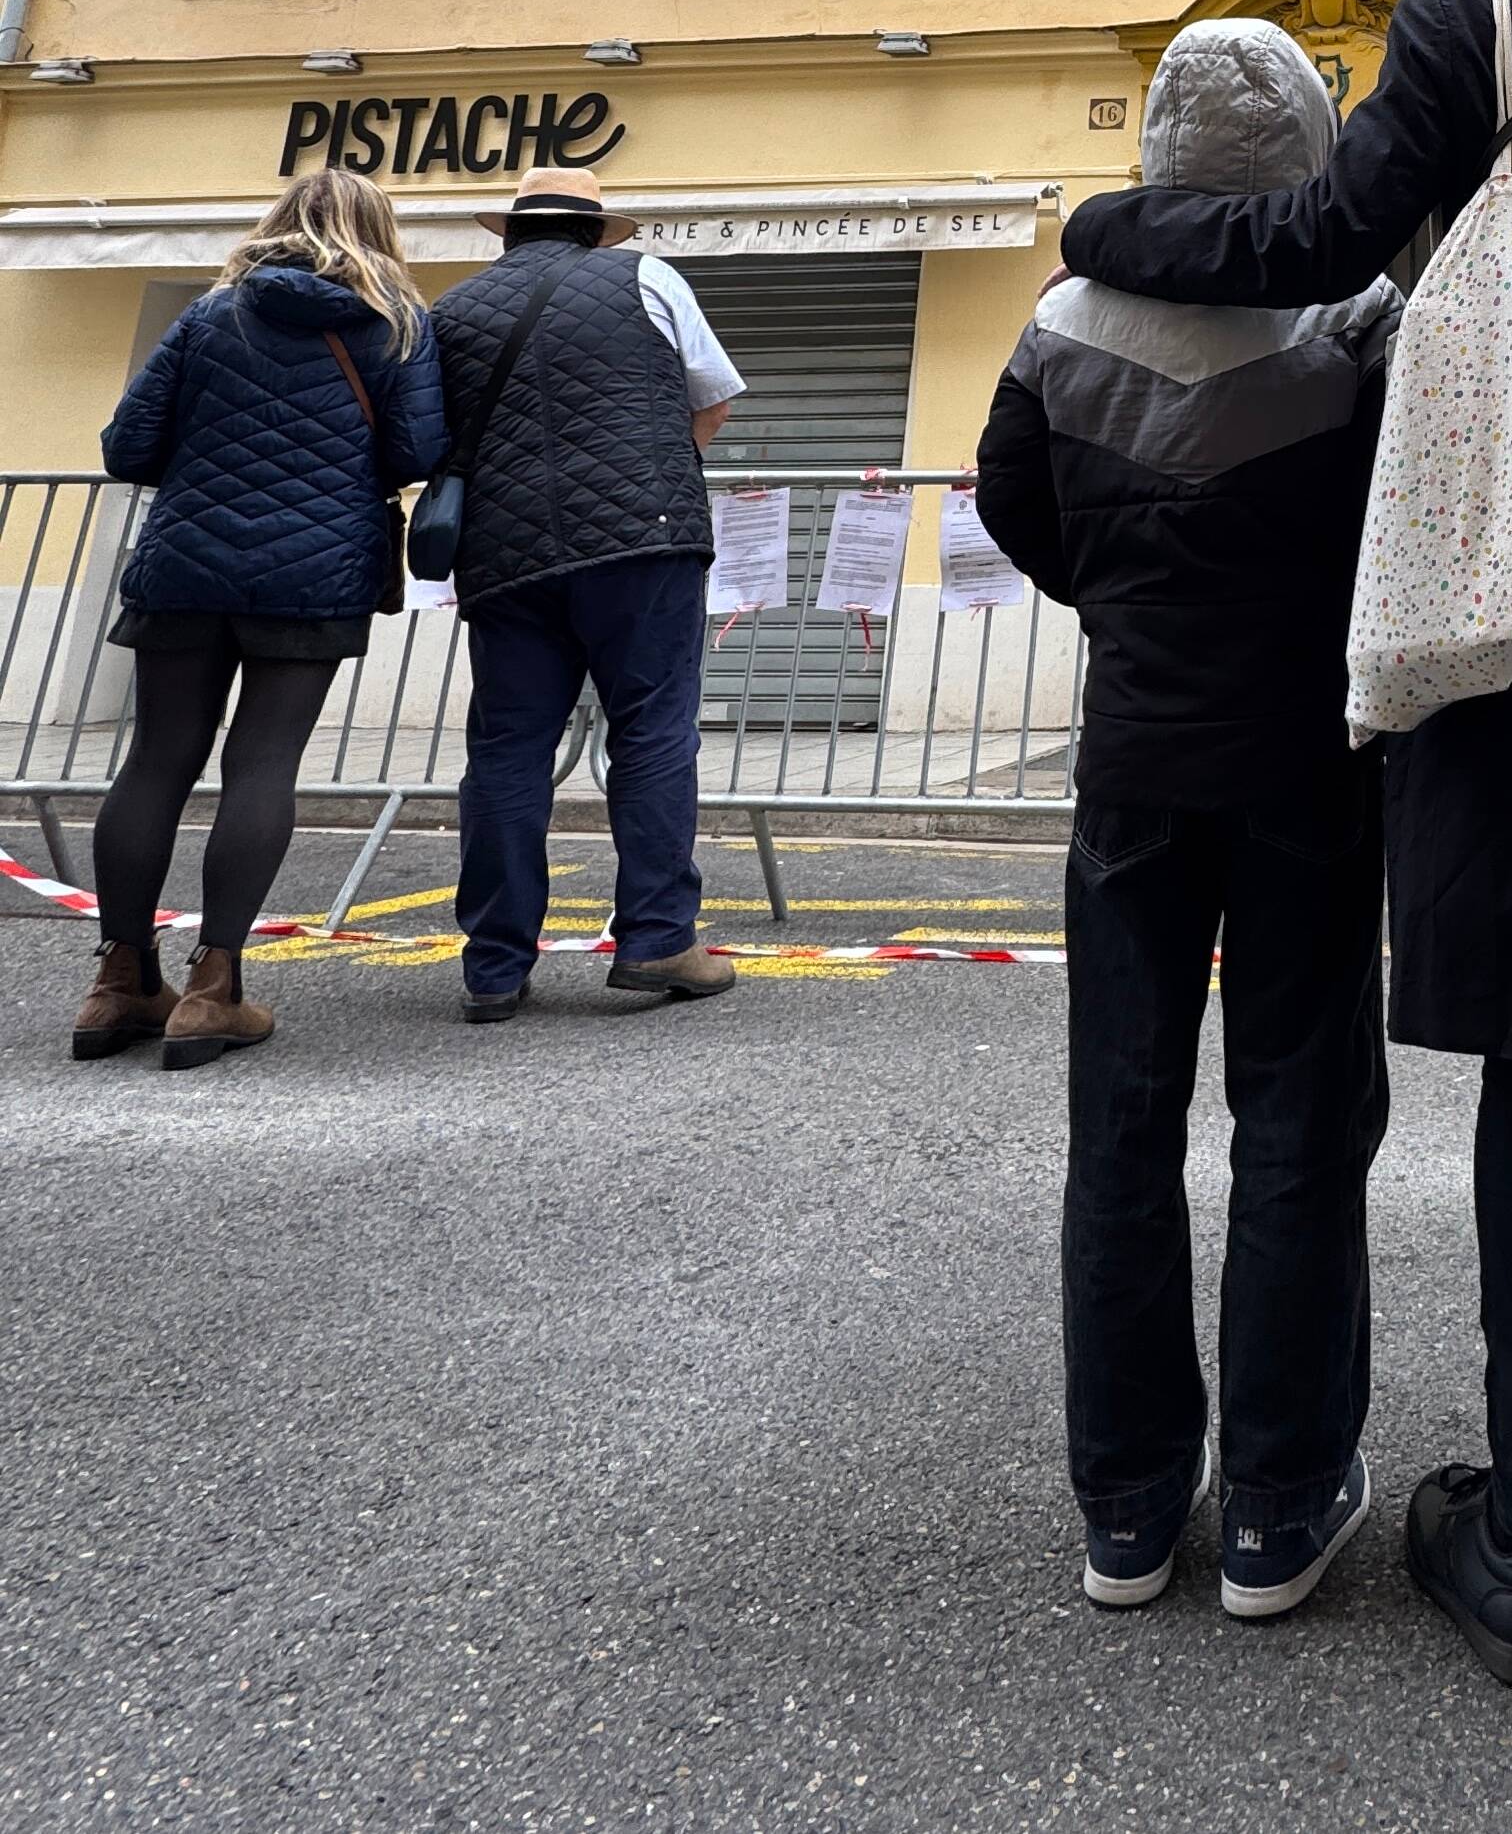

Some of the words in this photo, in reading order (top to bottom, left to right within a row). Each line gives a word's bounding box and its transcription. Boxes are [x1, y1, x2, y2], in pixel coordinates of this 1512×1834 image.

[1098, 106, 1118, 123] 16
[720, 221, 734, 238] &
[757, 212, 872, 238] PINCÉE
[894, 215, 928, 234] DE
[951, 213, 1003, 233] SEL
